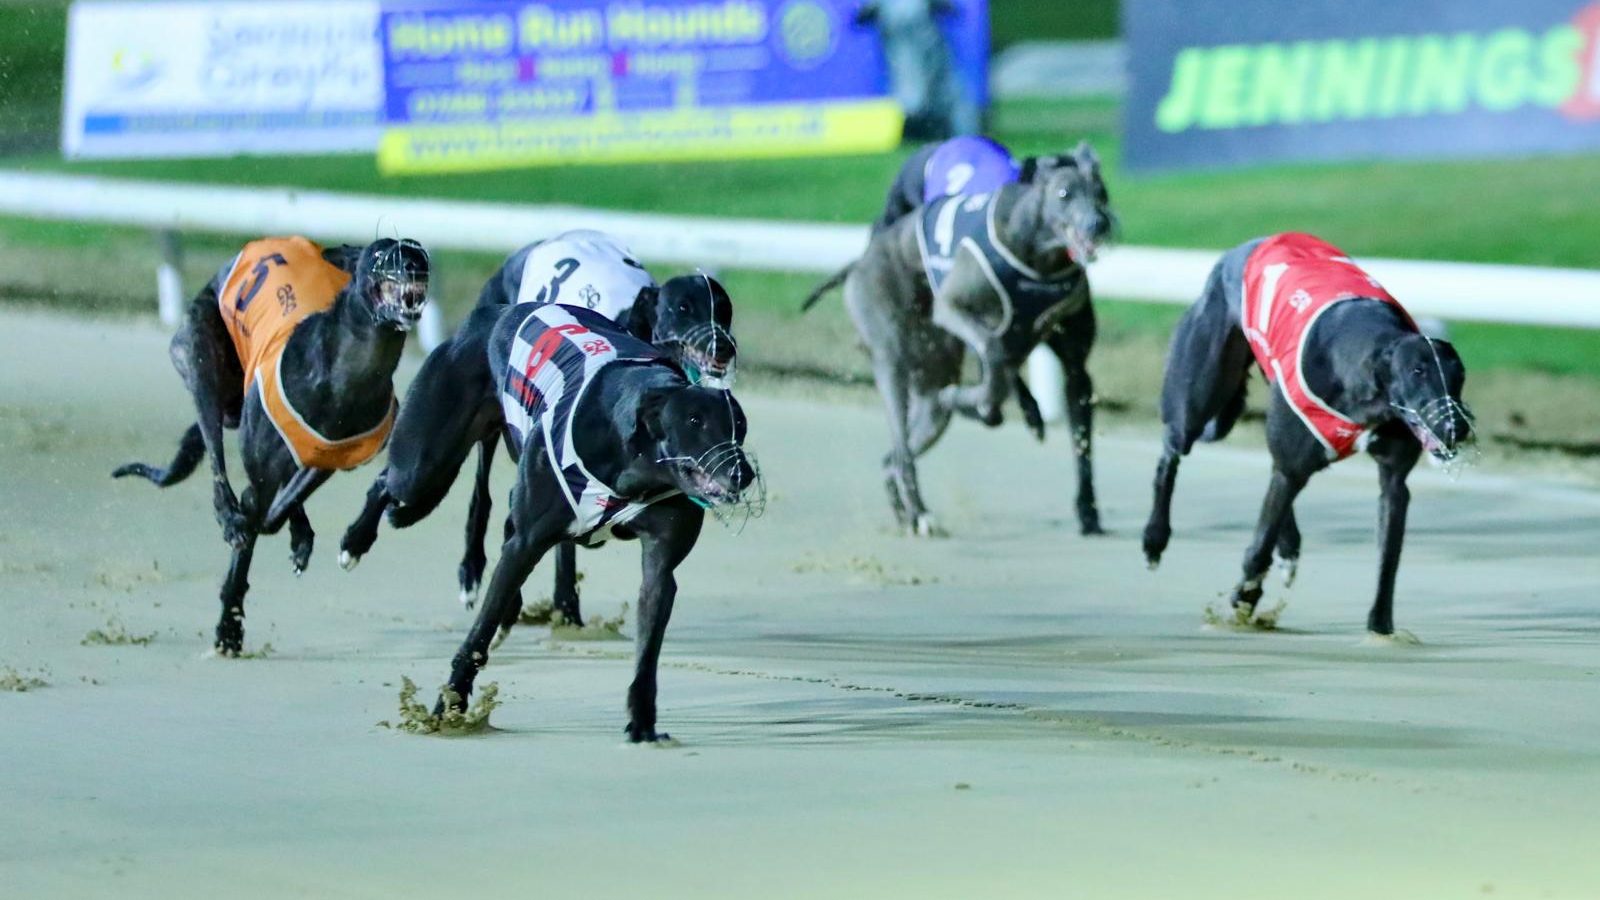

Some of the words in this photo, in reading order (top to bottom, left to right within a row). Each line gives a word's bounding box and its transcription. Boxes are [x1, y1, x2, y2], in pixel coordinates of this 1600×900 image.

[520, 8, 599, 48] Run
[1156, 26, 1583, 132] JENNINGS
[235, 253, 288, 313] 5
[536, 257, 581, 304] 3
[1258, 262, 1290, 334] 1
[525, 323, 590, 380] 6
